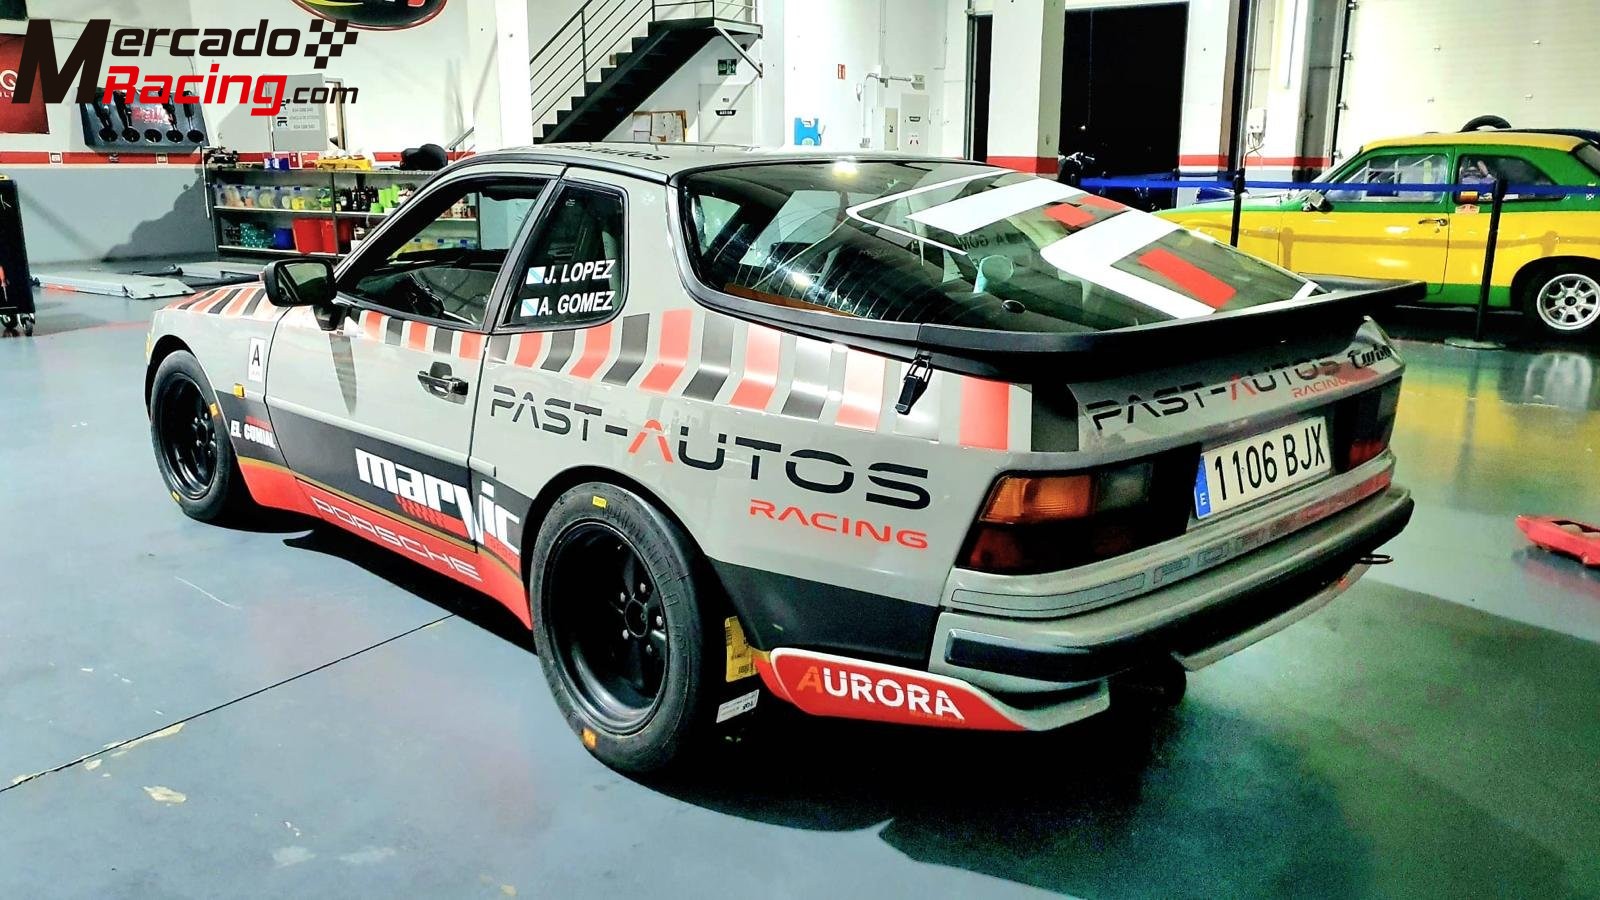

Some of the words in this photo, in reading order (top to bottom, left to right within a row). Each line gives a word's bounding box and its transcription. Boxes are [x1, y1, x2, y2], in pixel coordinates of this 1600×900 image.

[544, 265, 556, 285] J.
[560, 259, 616, 283] LOPEZ
[537, 296, 553, 317] A.
[557, 290, 616, 315] GOMEZ
[251, 344, 260, 367] A
[1085, 352, 1341, 430] PAST-AUTOS
[230, 420, 242, 438] EL
[490, 384, 931, 511] PAST-AUTOS
[1214, 440, 1278, 501] 1106
[1282, 423, 1325, 477] BJX
[355, 447, 520, 556] marvic
[749, 499, 928, 550] RACING
[1199, 492, 1207, 505] E
[311, 495, 483, 582] PORSCHE
[796, 665, 966, 722] AURORA
